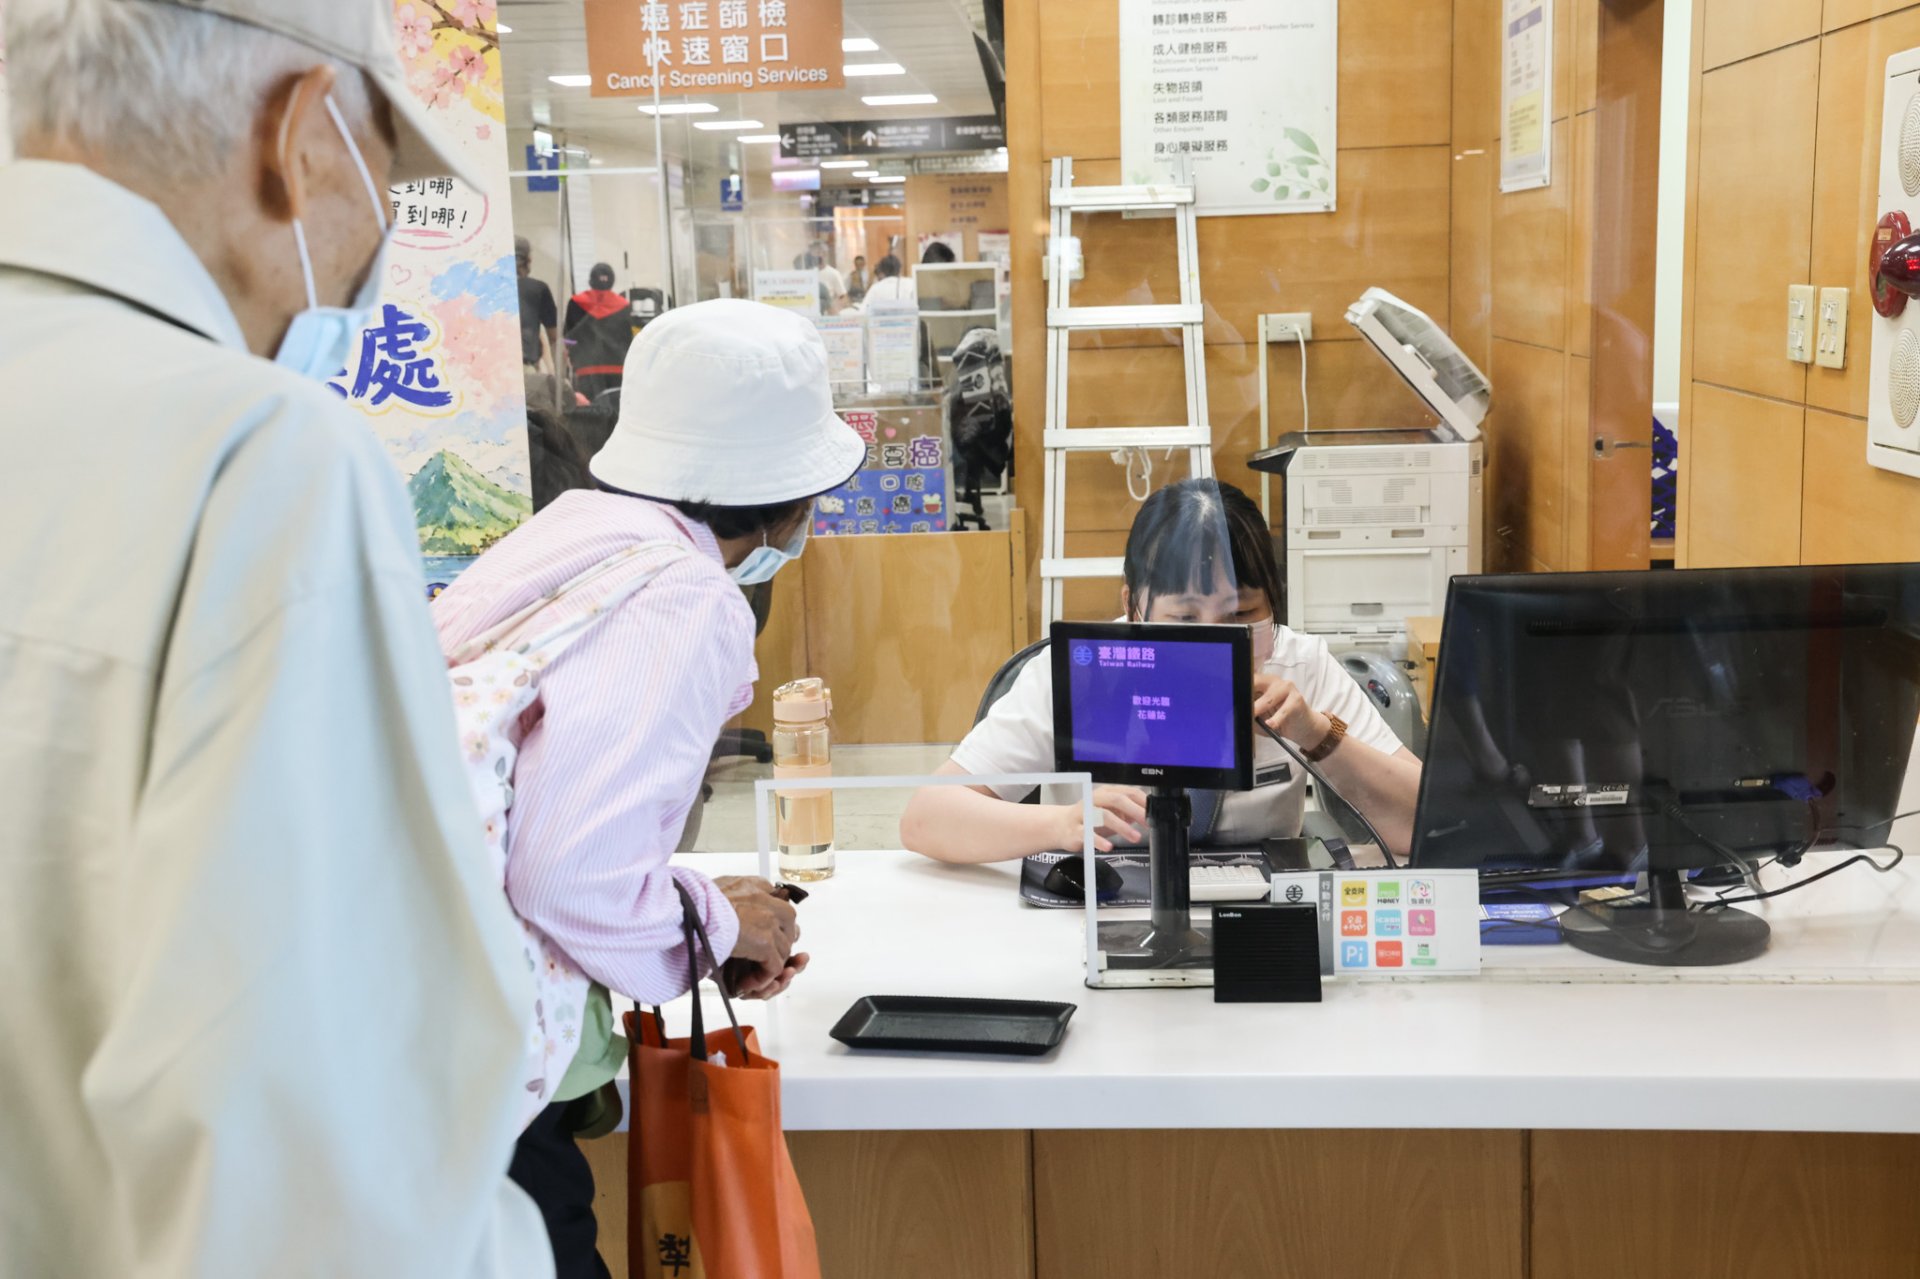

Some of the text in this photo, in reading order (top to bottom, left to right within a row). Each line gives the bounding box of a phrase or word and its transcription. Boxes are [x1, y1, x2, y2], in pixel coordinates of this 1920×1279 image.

[640, 0, 787, 31] 癌症篩檢
[1153, 11, 1228, 26] 轉診轉檢服務
[642, 33, 788, 67] 快速窗口
[1153, 41, 1228, 56] 成人健檢服務
[607, 66, 828, 90] Cancer Screening Services
[1153, 80, 1203, 94] 失物招領
[1182, 95, 1203, 103] Found
[1154, 110, 1228, 124] 各類服務諮詢
[1154, 140, 1228, 154] 身心障礙服務
[388, 177, 454, 199] 到哪
[1127, 661, 1155, 669] Railway
[1138, 709, 1166, 720] 花蓮站
[1346, 945, 1364, 962] Pi
